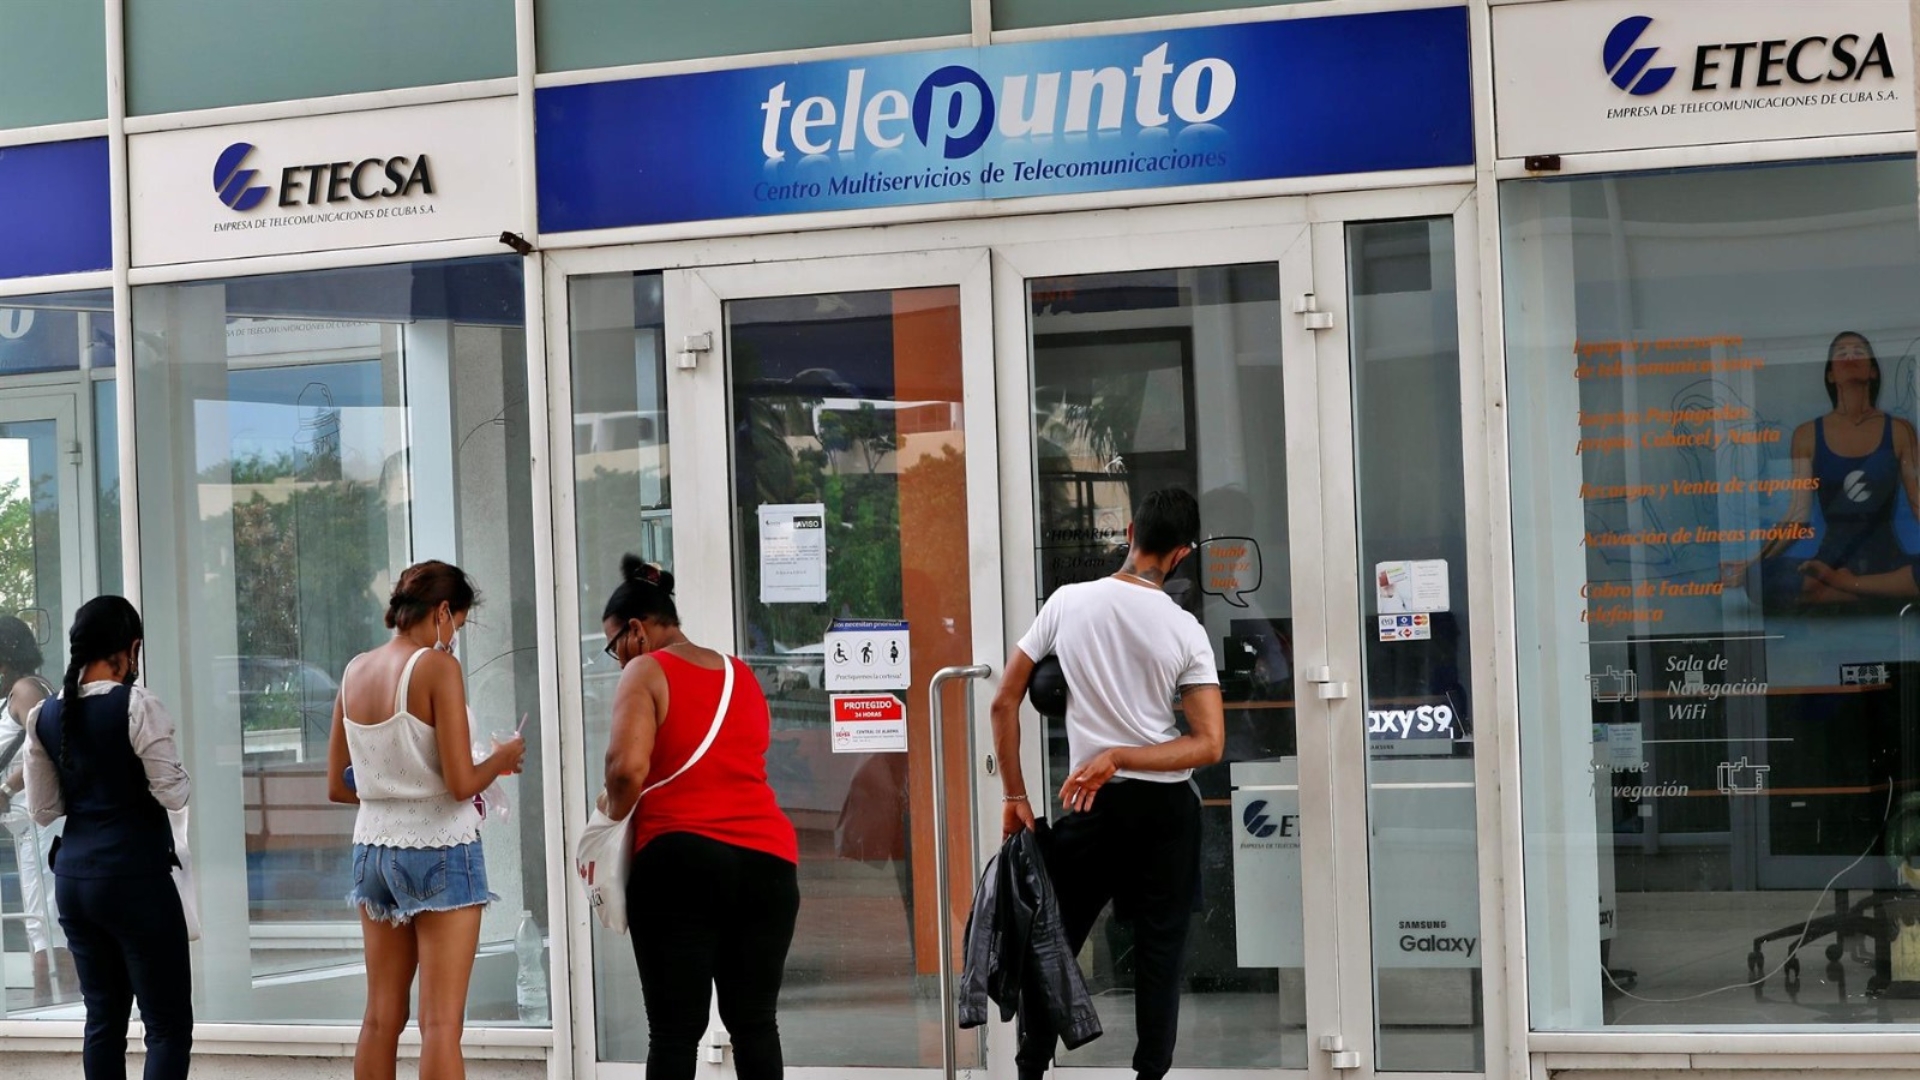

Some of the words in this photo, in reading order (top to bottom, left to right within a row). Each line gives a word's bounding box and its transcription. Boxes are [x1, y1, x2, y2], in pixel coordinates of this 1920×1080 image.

[1692, 32, 1895, 91] ETECSA
[760, 41, 1237, 159] telepunto
[1607, 106, 1658, 119] EMPRESA
[1660, 104, 1677, 115] DE
[1680, 96, 1818, 114] TELECOMUNICACIONES
[1821, 94, 1837, 105] DE
[1840, 92, 1873, 104] CUBA
[1877, 90, 1899, 102] S.A.
[278, 154, 435, 208] ETECSA
[754, 177, 821, 202] Centro
[828, 168, 972, 196] Multiservicios
[979, 162, 1005, 184] de
[1013, 149, 1227, 181] Telecomunicaciones
[213, 220, 253, 233] EMPRESA
[254, 218, 267, 229] DE
[269, 209, 374, 228] TELECOMUNICACIONES
[376, 208, 390, 218] DE
[391, 205, 418, 217] CUBA
[419, 204, 436, 215] S.A.
[1598, 356, 1765, 377] telecomunicaciones
[1641, 428, 1710, 449] Cubacel
[1711, 434, 1722, 452] y
[1727, 427, 1781, 444] Nauta
[1659, 482, 1669, 499] y
[1671, 479, 1719, 496] Venta
[1725, 475, 1746, 494] de
[1749, 477, 1821, 498] cupones
[796, 520, 819, 529] AVISO
[1051, 527, 1116, 541] HORARIO
[1579, 528, 1668, 547] Activación
[1671, 525, 1693, 544] de
[1695, 525, 1746, 543] líneas
[1750, 521, 1816, 542] móviles
[1580, 582, 1632, 599] Cobro
[1635, 580, 1655, 598] de
[1658, 578, 1724, 597] Factura
[1665, 654, 1704, 672] Sala
[1707, 653, 1729, 671] de
[1667, 677, 1769, 700] Navegación
[844, 701, 892, 710] PROTEGIDO
[1668, 703, 1708, 720] WiFi
[1399, 921, 1447, 929] SAMSUNG
[1400, 934, 1477, 958] Galaxy
